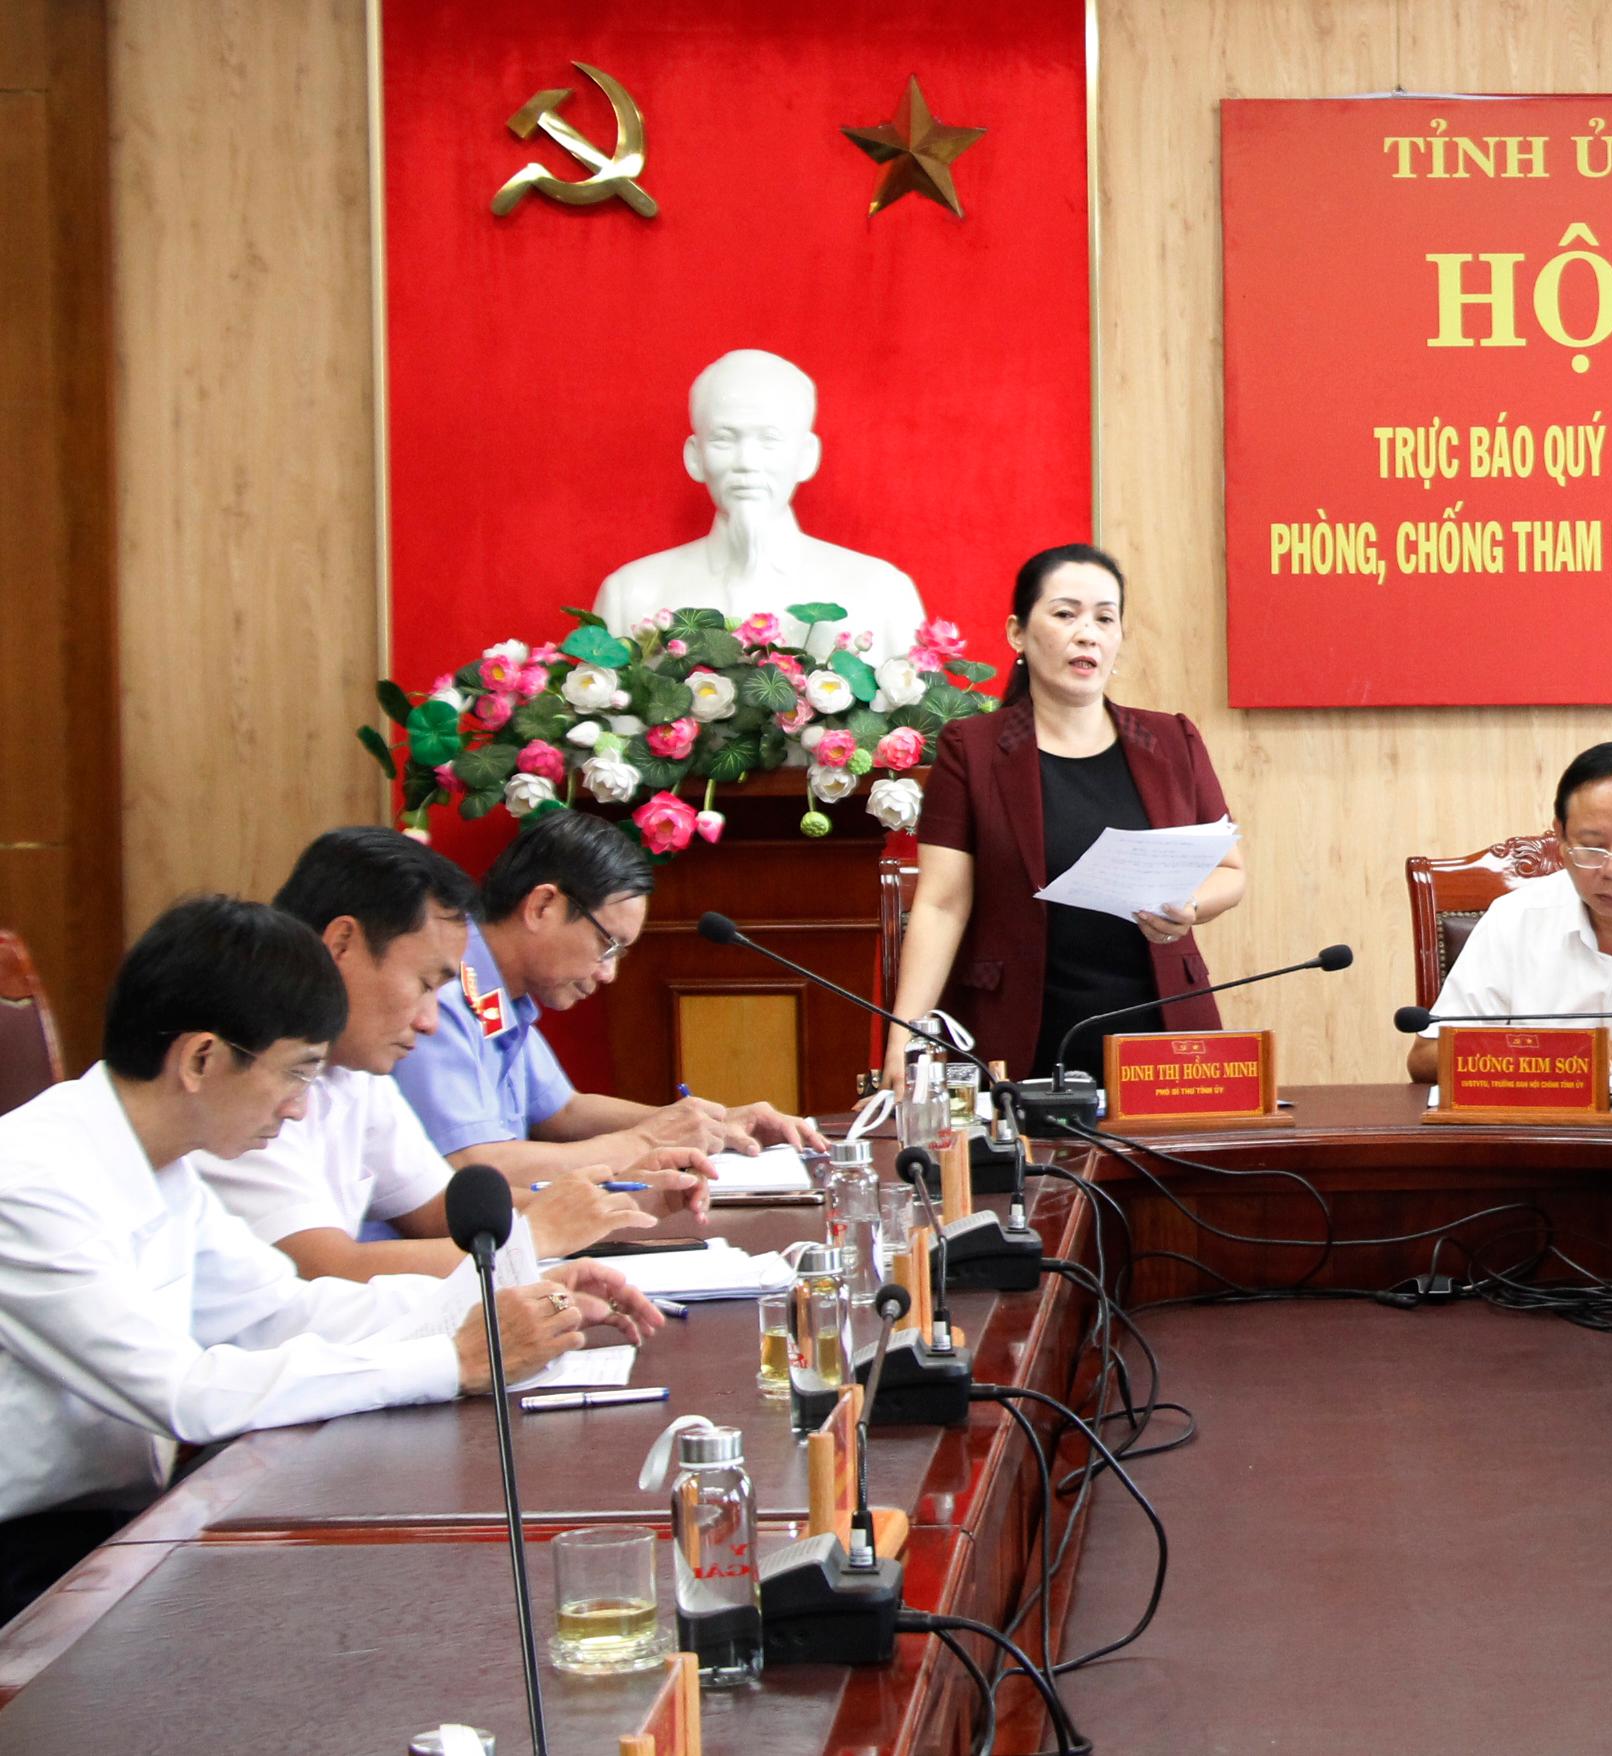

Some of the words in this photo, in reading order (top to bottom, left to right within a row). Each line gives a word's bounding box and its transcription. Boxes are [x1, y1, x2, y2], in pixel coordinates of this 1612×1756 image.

[1384, 118, 1550, 178] TỈNH
[1374, 420, 1459, 489] TRỰC
[1470, 412, 1534, 478] BÁO
[1544, 411, 1606, 486] QUÝ
[1271, 509, 1386, 584] PHÒNG,
[1397, 501, 1503, 575] CHỐNG
[1512, 521, 1602, 573] THAM
[1121, 1065, 1154, 1081] ĐINH
[1157, 1064, 1179, 1083] THỊ
[1184, 1056, 1220, 1079] HỒNG
[1223, 1061, 1258, 1078] MINH
[1457, 1053, 1514, 1073] LƯƠNG
[1518, 1057, 1551, 1073] KIM
[1555, 1055, 1590, 1073] SƠN
